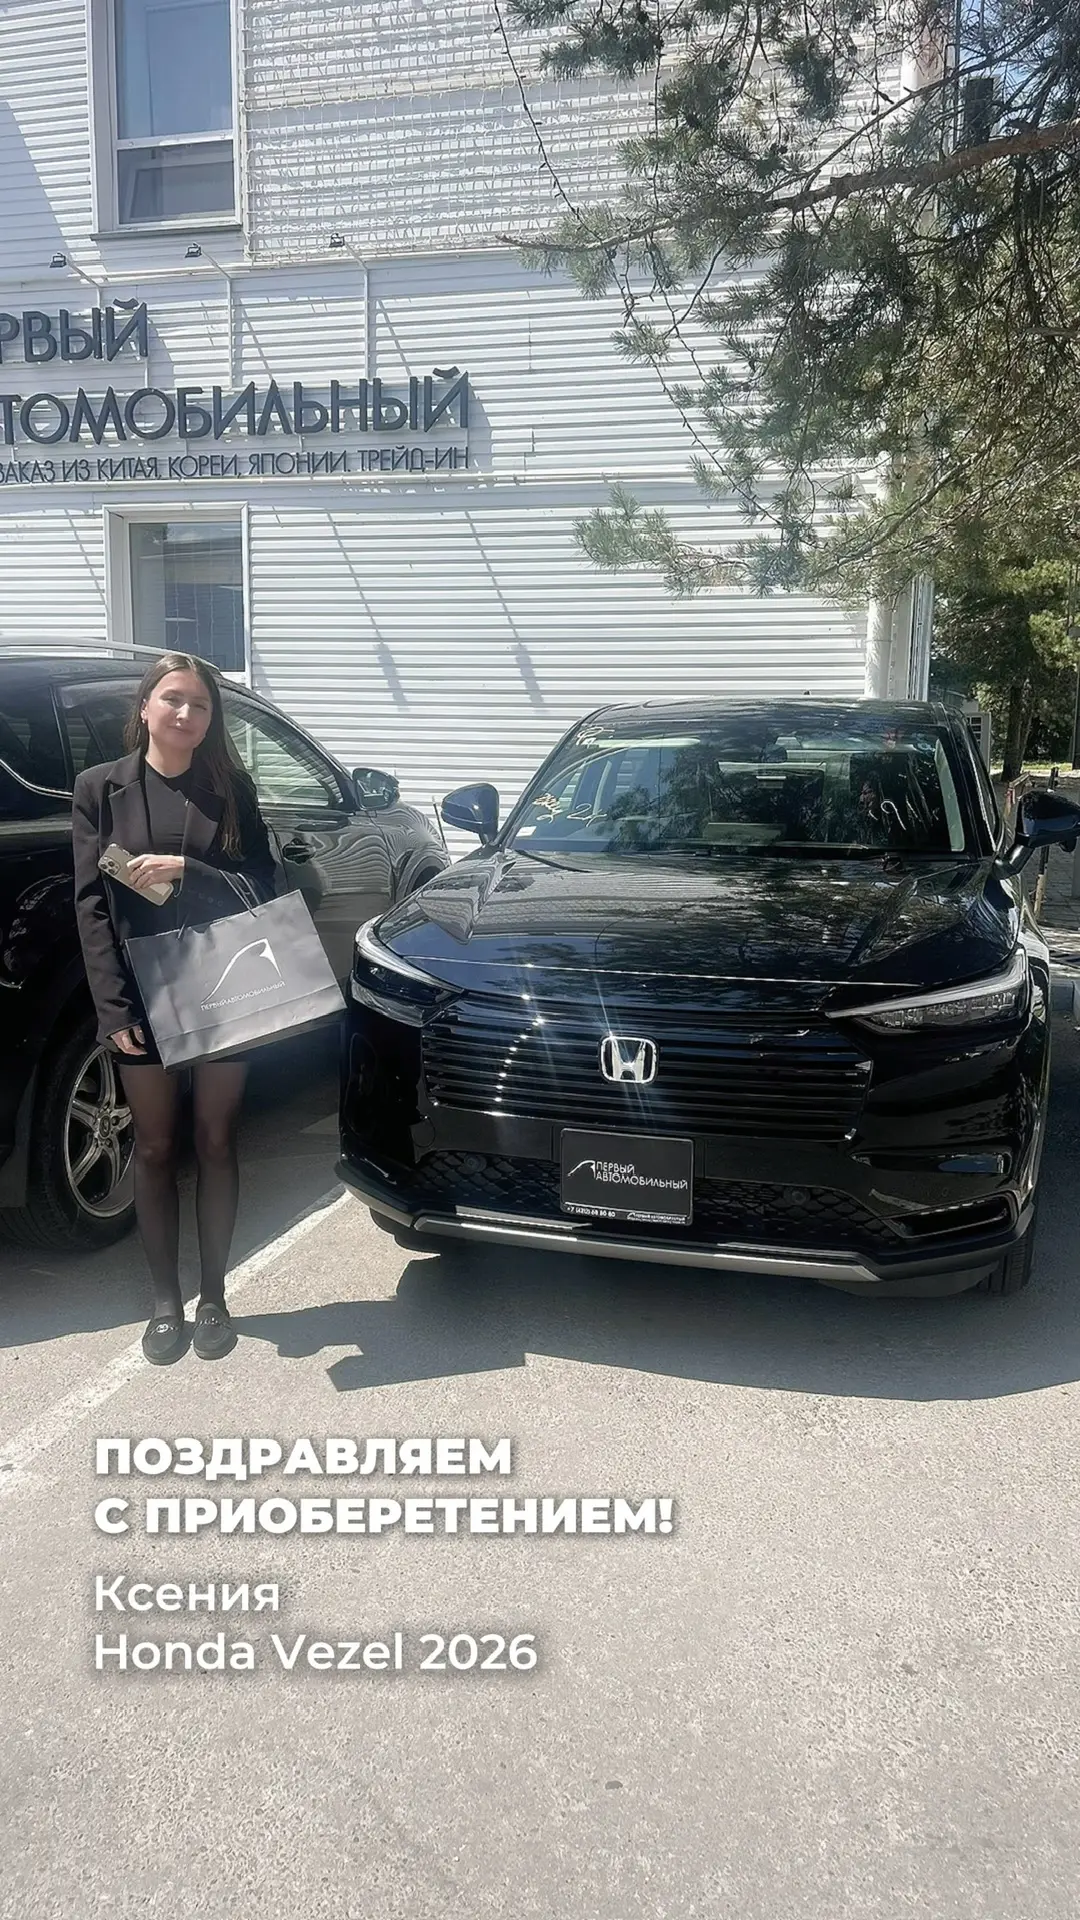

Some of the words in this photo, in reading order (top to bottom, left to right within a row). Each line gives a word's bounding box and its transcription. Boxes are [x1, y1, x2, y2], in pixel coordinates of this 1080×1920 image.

[62, 458, 91, 482] ИЗ
[97, 456, 162, 480] КИТАЯ,
[168, 453, 241, 478] КОРЕИ,
[357, 445, 469, 473] ТРЕЙД-ИН
[596, 1161, 636, 1175] ПЕРВЫЙ
[595, 1171, 688, 1190] АВТОМОБИЛЬНЫЙ
